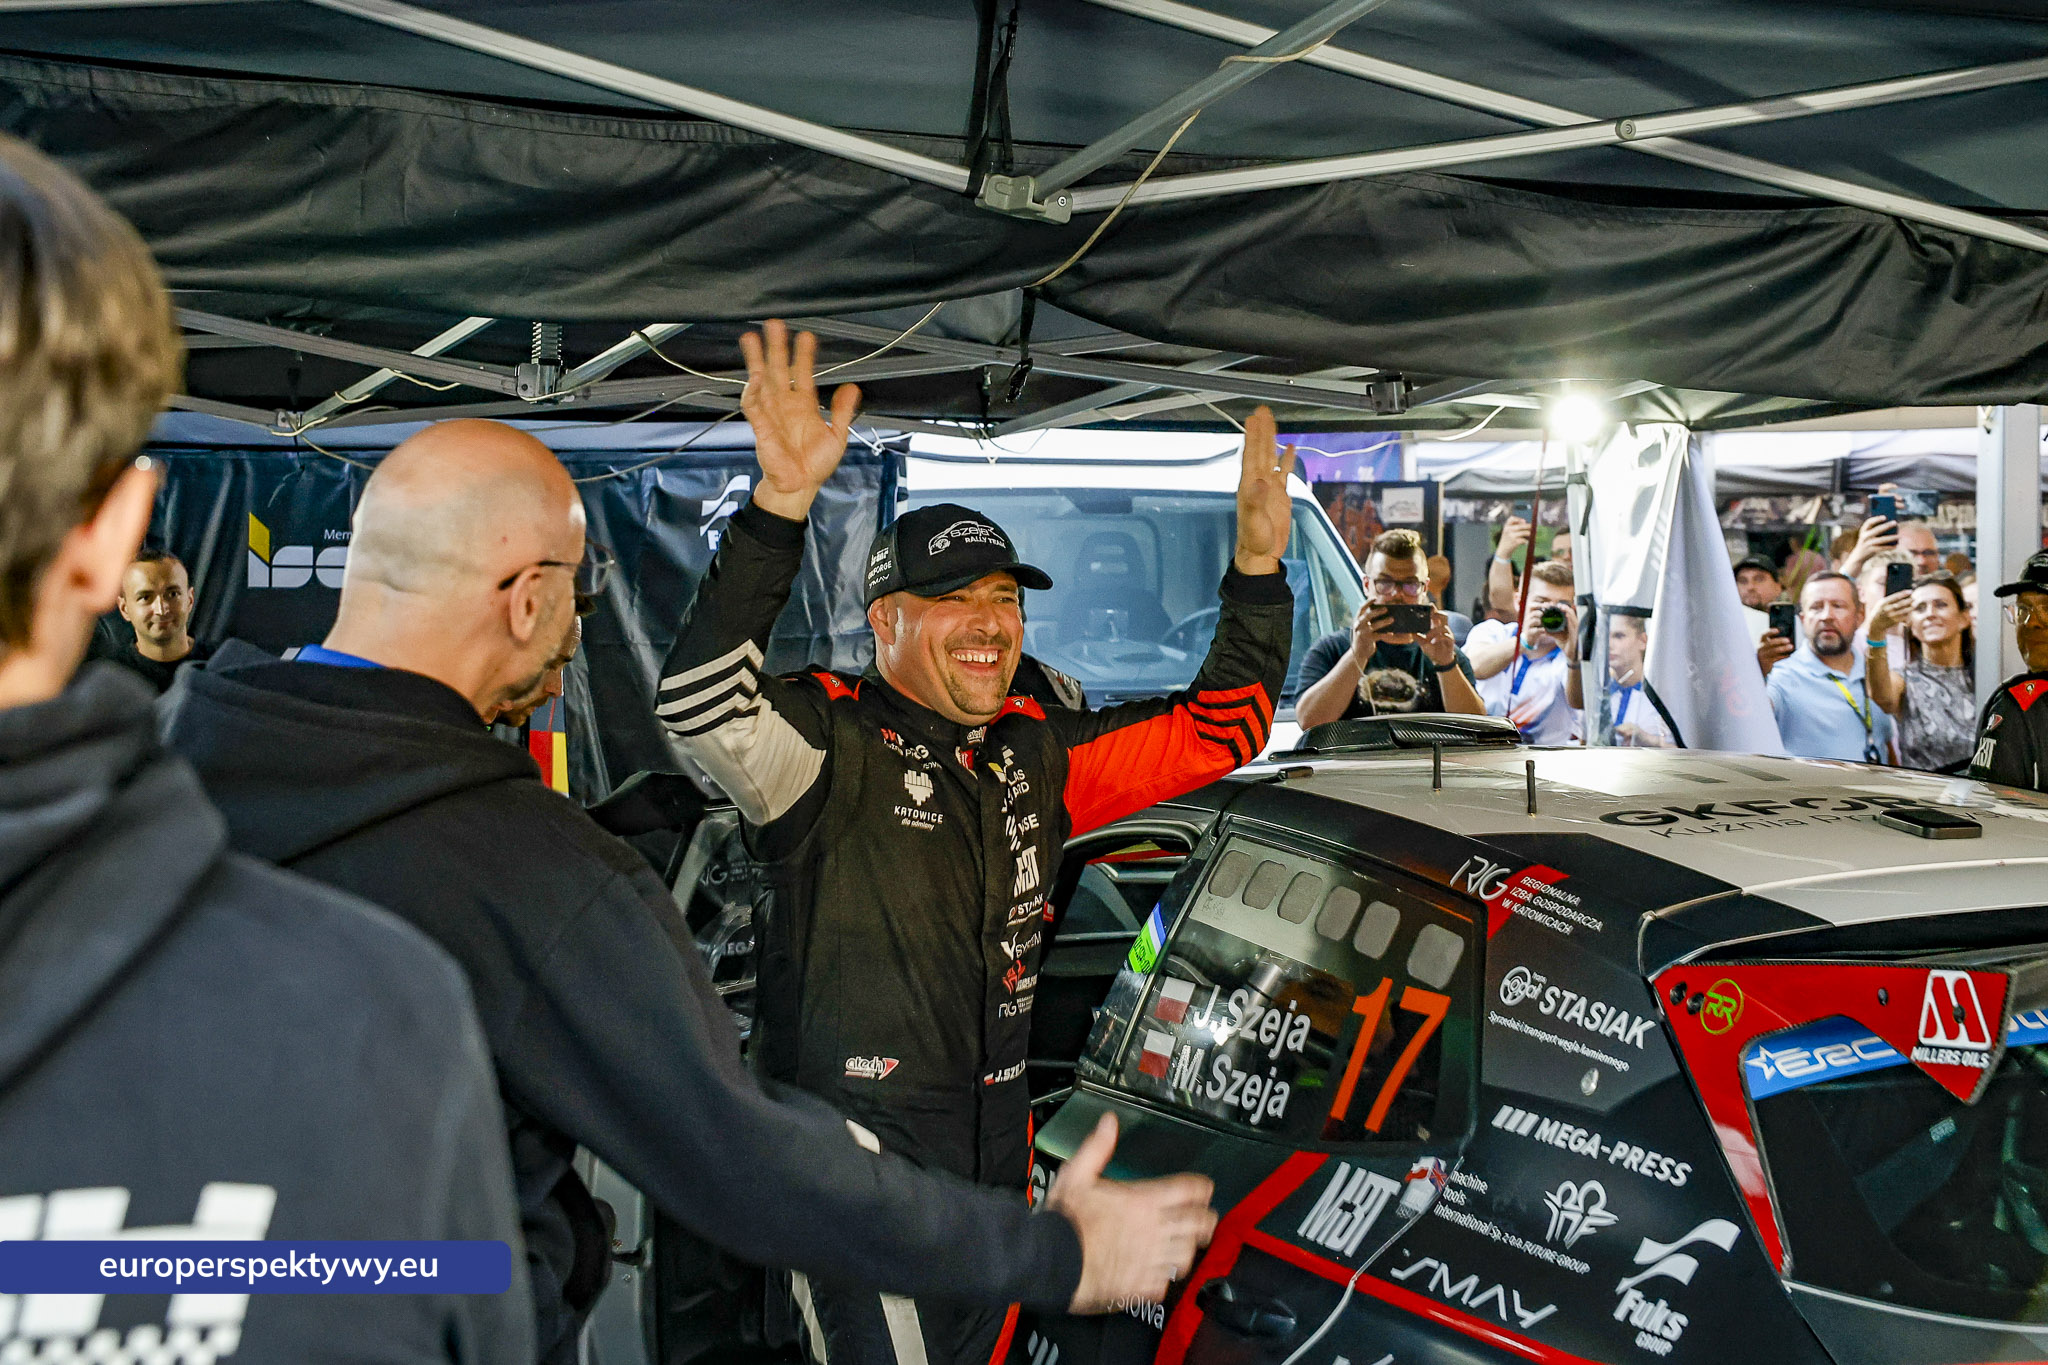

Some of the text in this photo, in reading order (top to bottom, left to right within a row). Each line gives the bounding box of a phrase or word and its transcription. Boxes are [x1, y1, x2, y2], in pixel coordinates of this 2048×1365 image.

[965, 536, 987, 544] RALLY
[894, 805, 944, 824] KATOWICE
[1509, 886, 1604, 932] IZBA GOSPODARCZA
[1520, 876, 1581, 907] REGIONALNA
[1501, 897, 1574, 935] W KATOWICACH
[1539, 986, 1657, 1049] STASIAK
[1330, 976, 1451, 1134] 17
[1580, 1043, 1630, 1072] kamiennego
[1775, 1036, 1897, 1079] ERC
[1911, 1046, 1990, 1069] MILLERS OILS
[1534, 1116, 1693, 1187] MEGA-PRESS
[1443, 1185, 1468, 1206] tools
[1450, 1170, 1489, 1195] machine
[1433, 1201, 1492, 1236] international
[1613, 1287, 1689, 1341] Fuks
